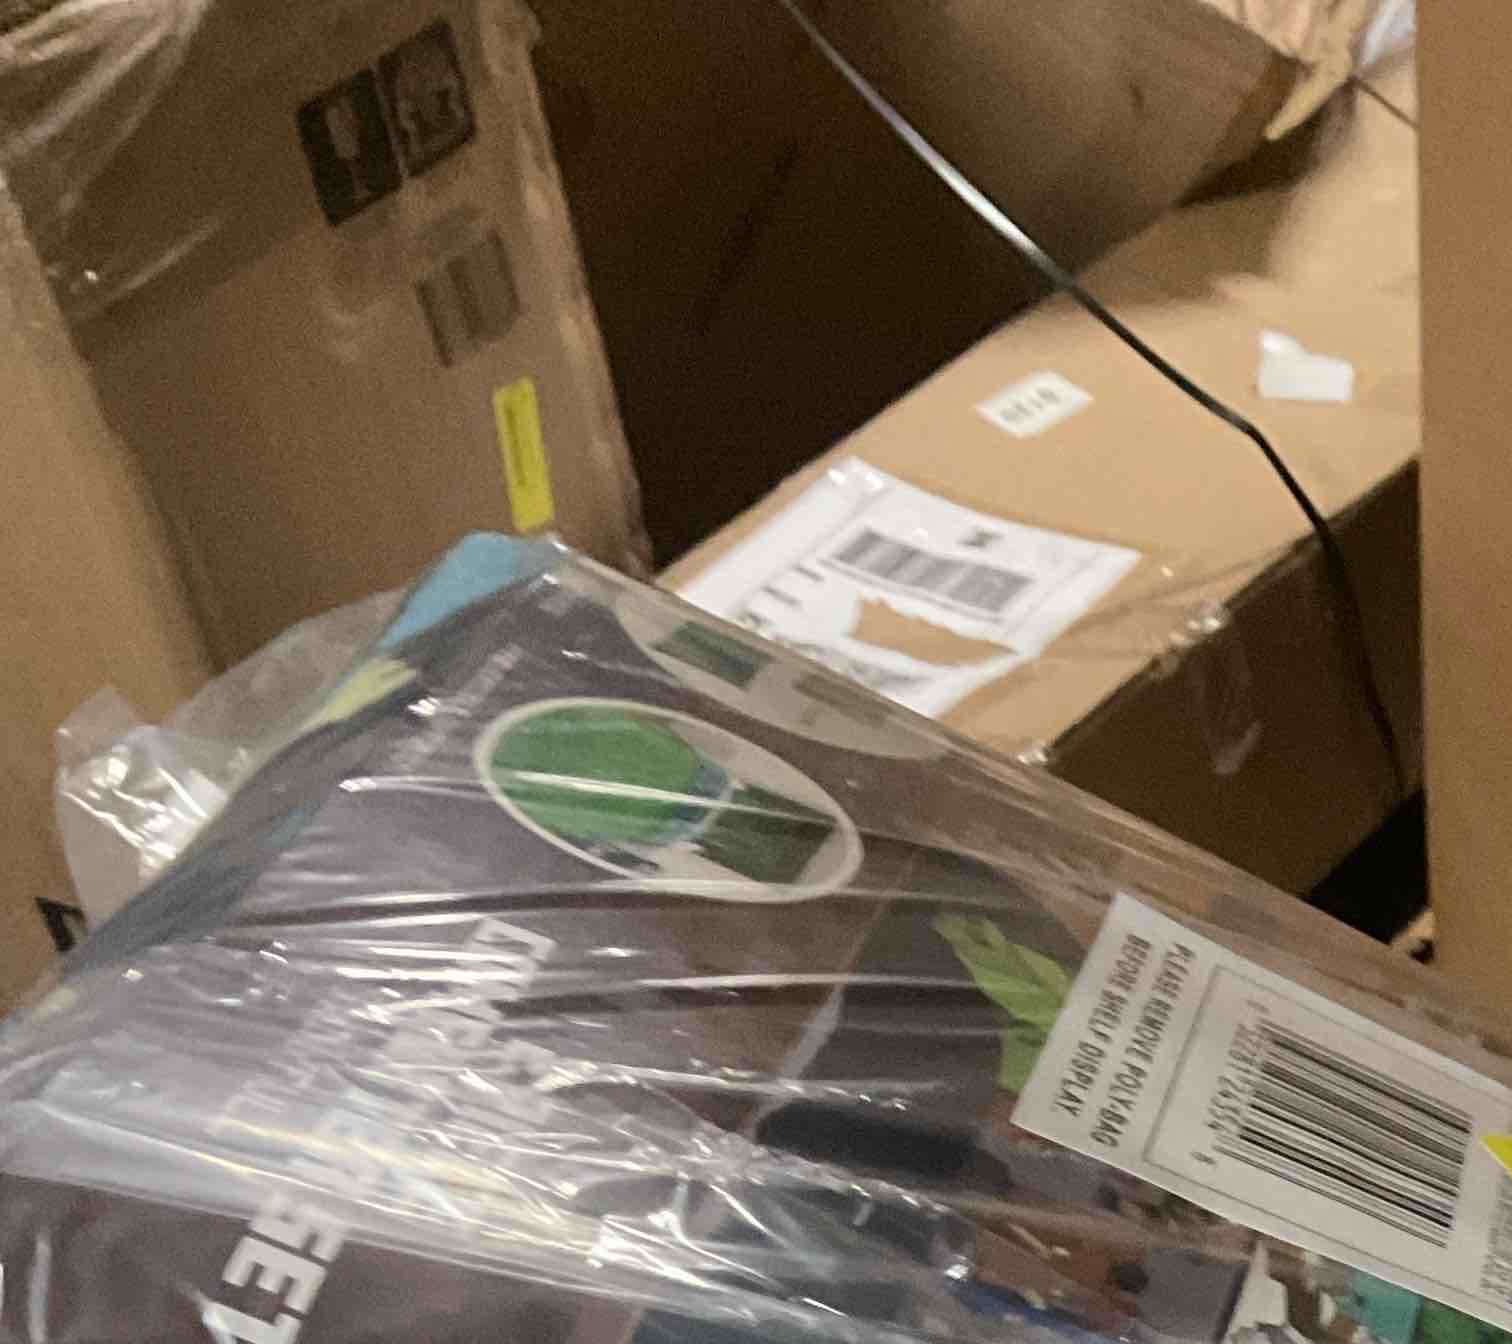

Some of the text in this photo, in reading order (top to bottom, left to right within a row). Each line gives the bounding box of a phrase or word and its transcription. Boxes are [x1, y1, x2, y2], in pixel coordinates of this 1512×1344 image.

[1106, 933, 1151, 993] BEFORE
[1083, 989, 1129, 1044] SHELF
[1089, 942, 1196, 1150] PLEASE REMOVE POLY-BAG
